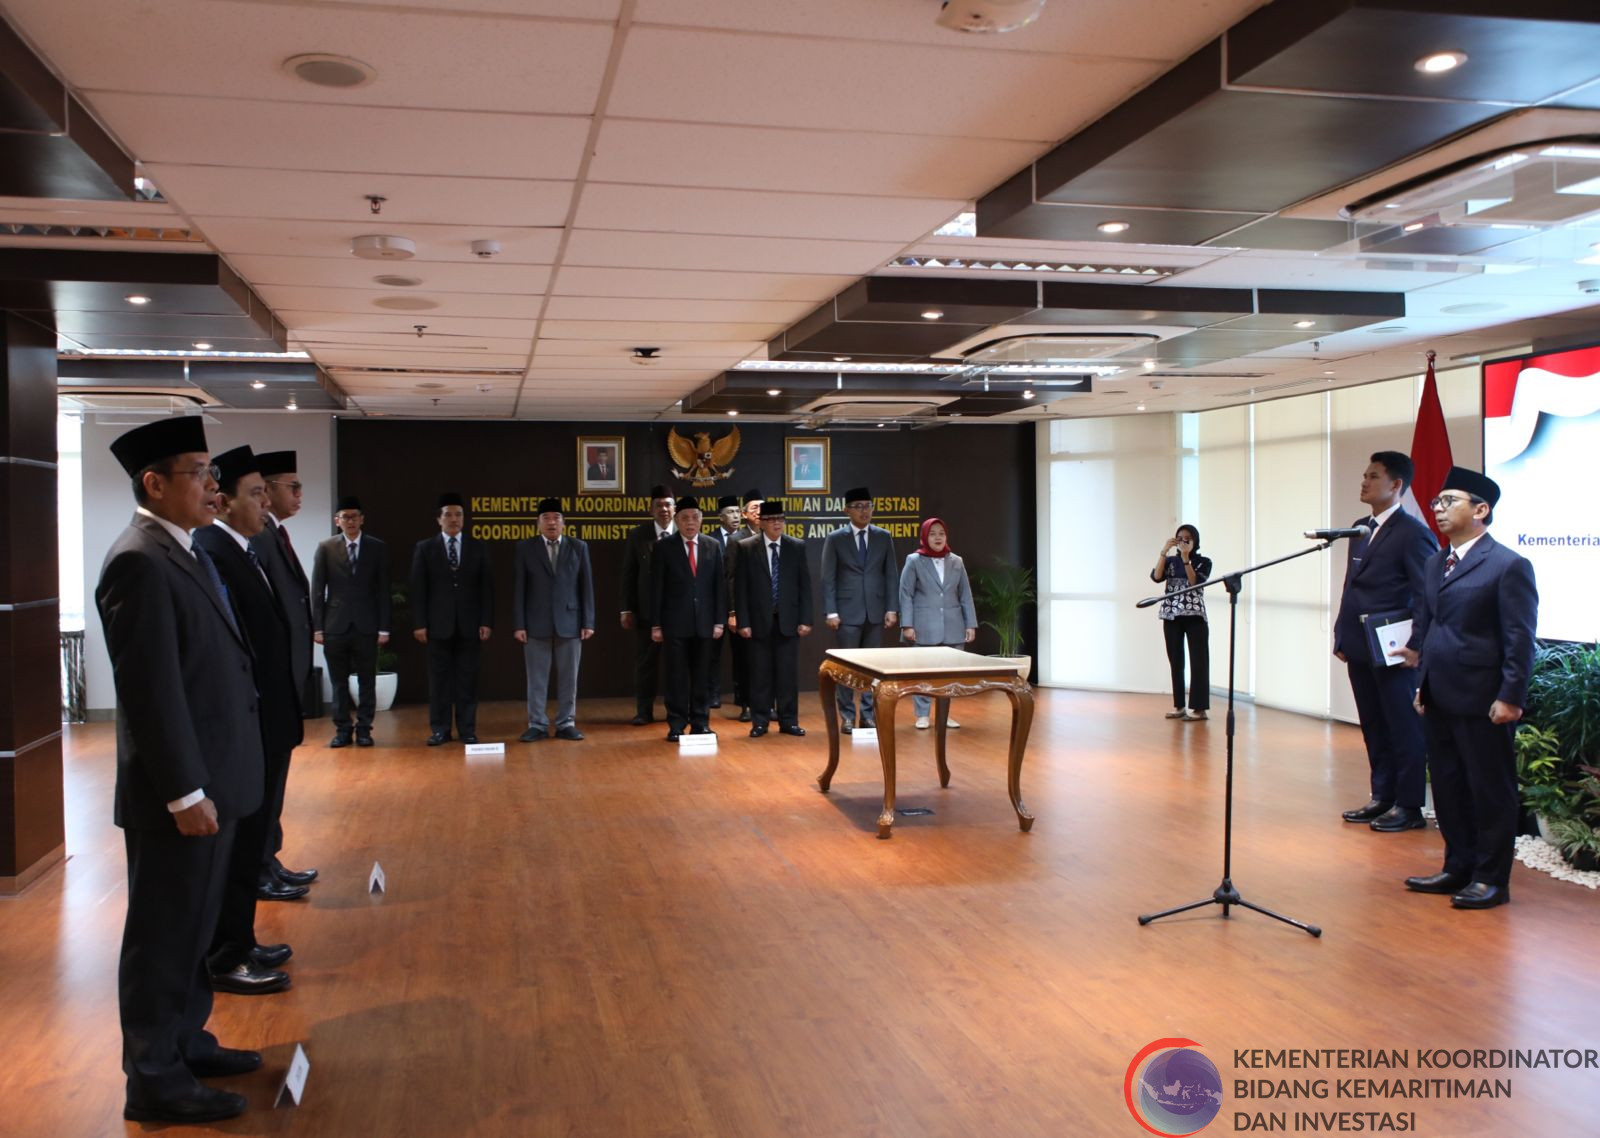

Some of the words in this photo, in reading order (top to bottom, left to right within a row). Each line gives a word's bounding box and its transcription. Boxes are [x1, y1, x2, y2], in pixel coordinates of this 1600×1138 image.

[472, 496, 571, 512] KEMENTEN
[575, 496, 652, 512] KOORDINAT
[472, 524, 577, 540] COORDING
[581, 524, 641, 540] MINIST
[807, 523, 835, 539] AND
